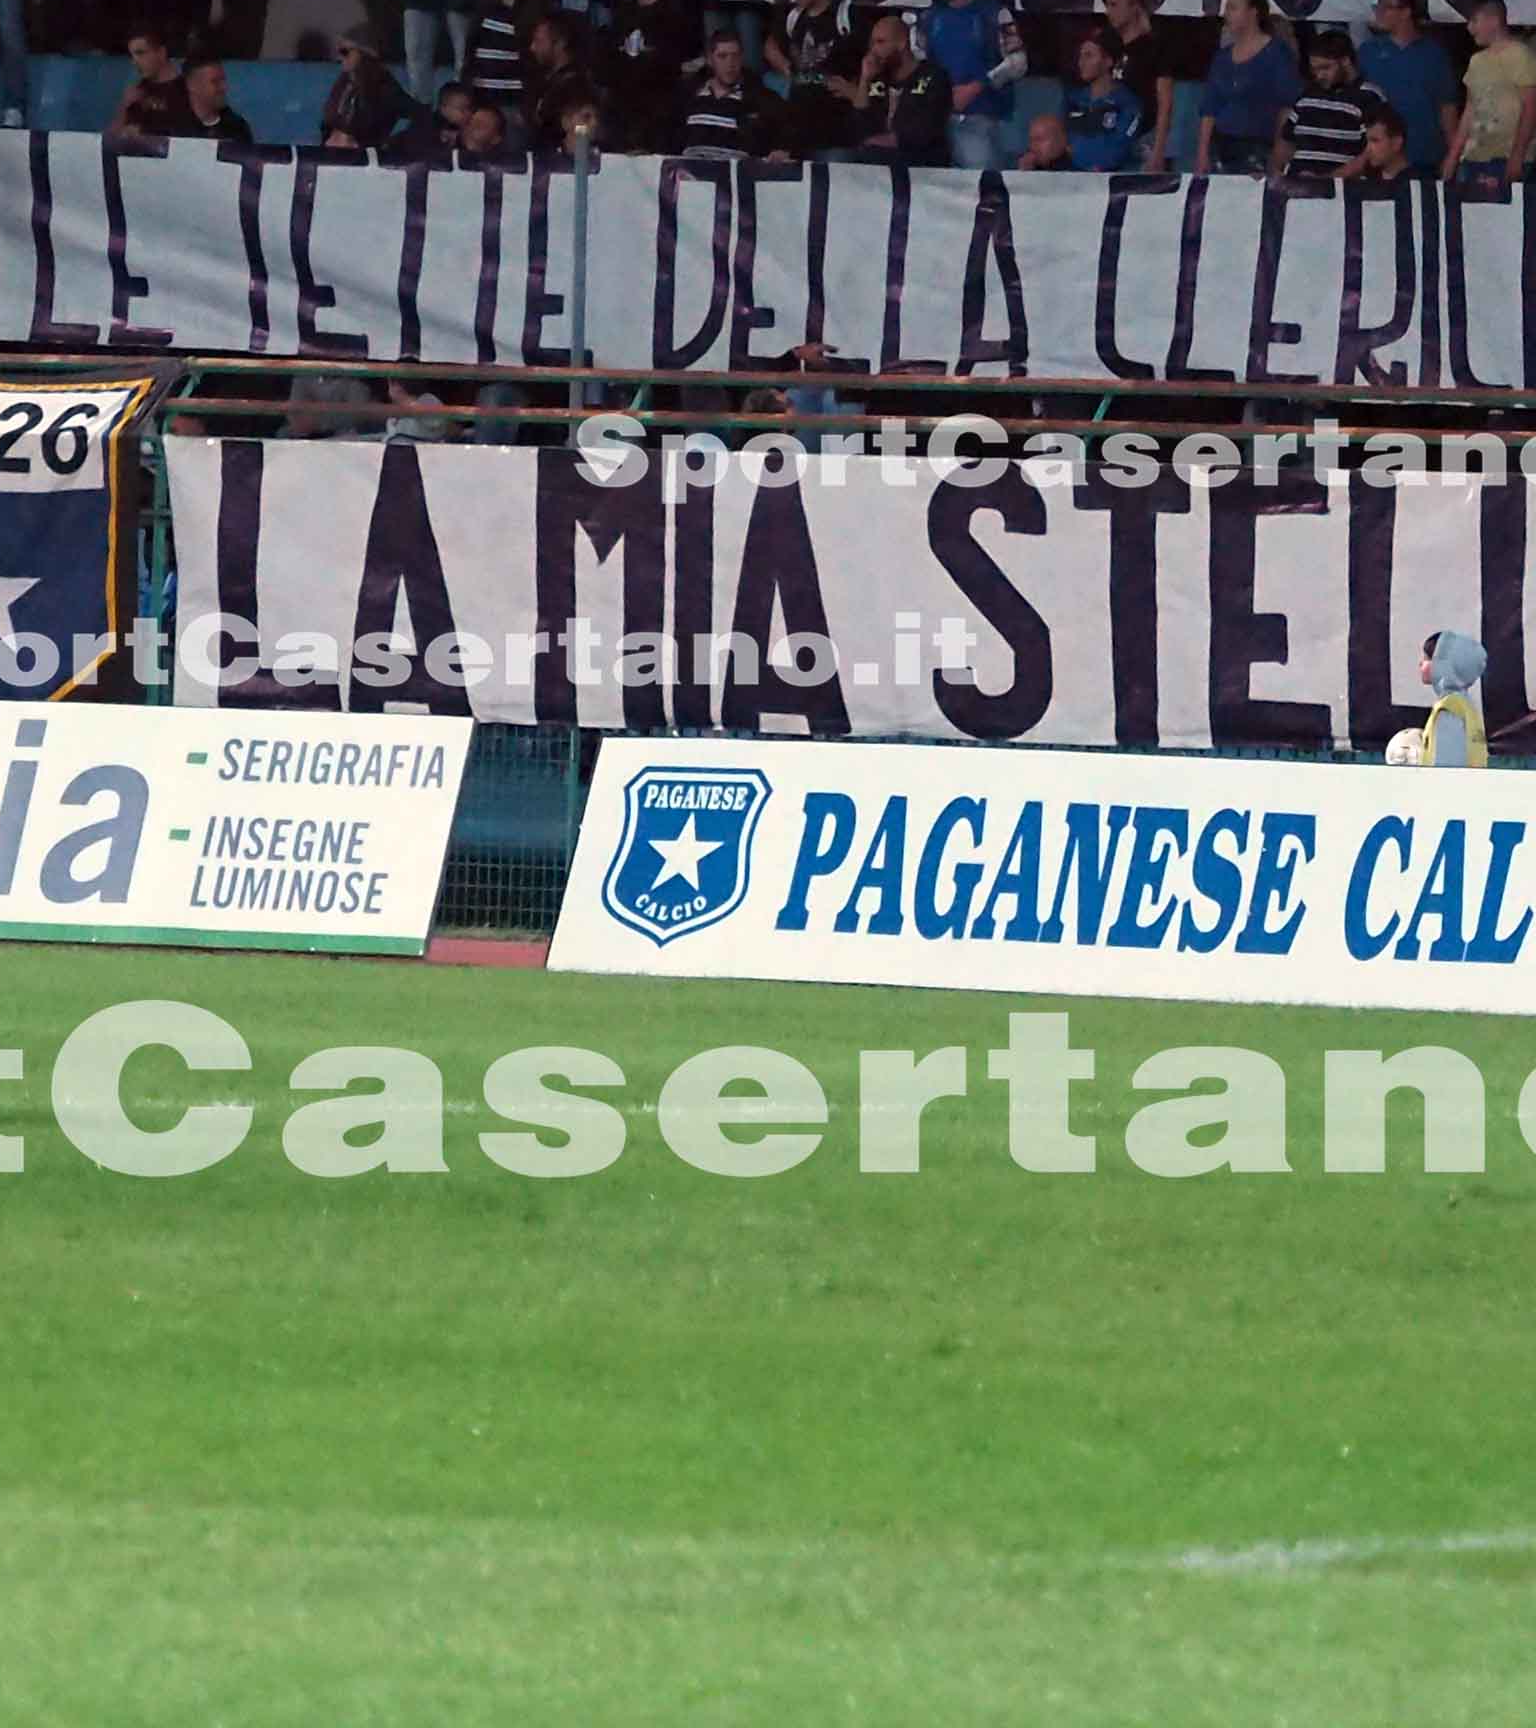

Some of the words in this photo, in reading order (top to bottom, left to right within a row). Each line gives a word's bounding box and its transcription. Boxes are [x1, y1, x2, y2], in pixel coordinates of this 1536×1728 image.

[30, 129, 174, 345] LE
[216, 142, 601, 370] TETTE
[653, 159, 1029, 378] DELLA
[217, 439, 473, 717] LA
[534, 447, 853, 734] MIA
[218, 738, 446, 789] SERIGRAFIA
[643, 784, 749, 811] PAGANESE
[201, 815, 371, 865] INSEGNE
[189, 868, 389, 915] LUMINOSE
[775, 791, 1316, 956] PAGANESE
[635, 893, 708, 922] CALCIO
